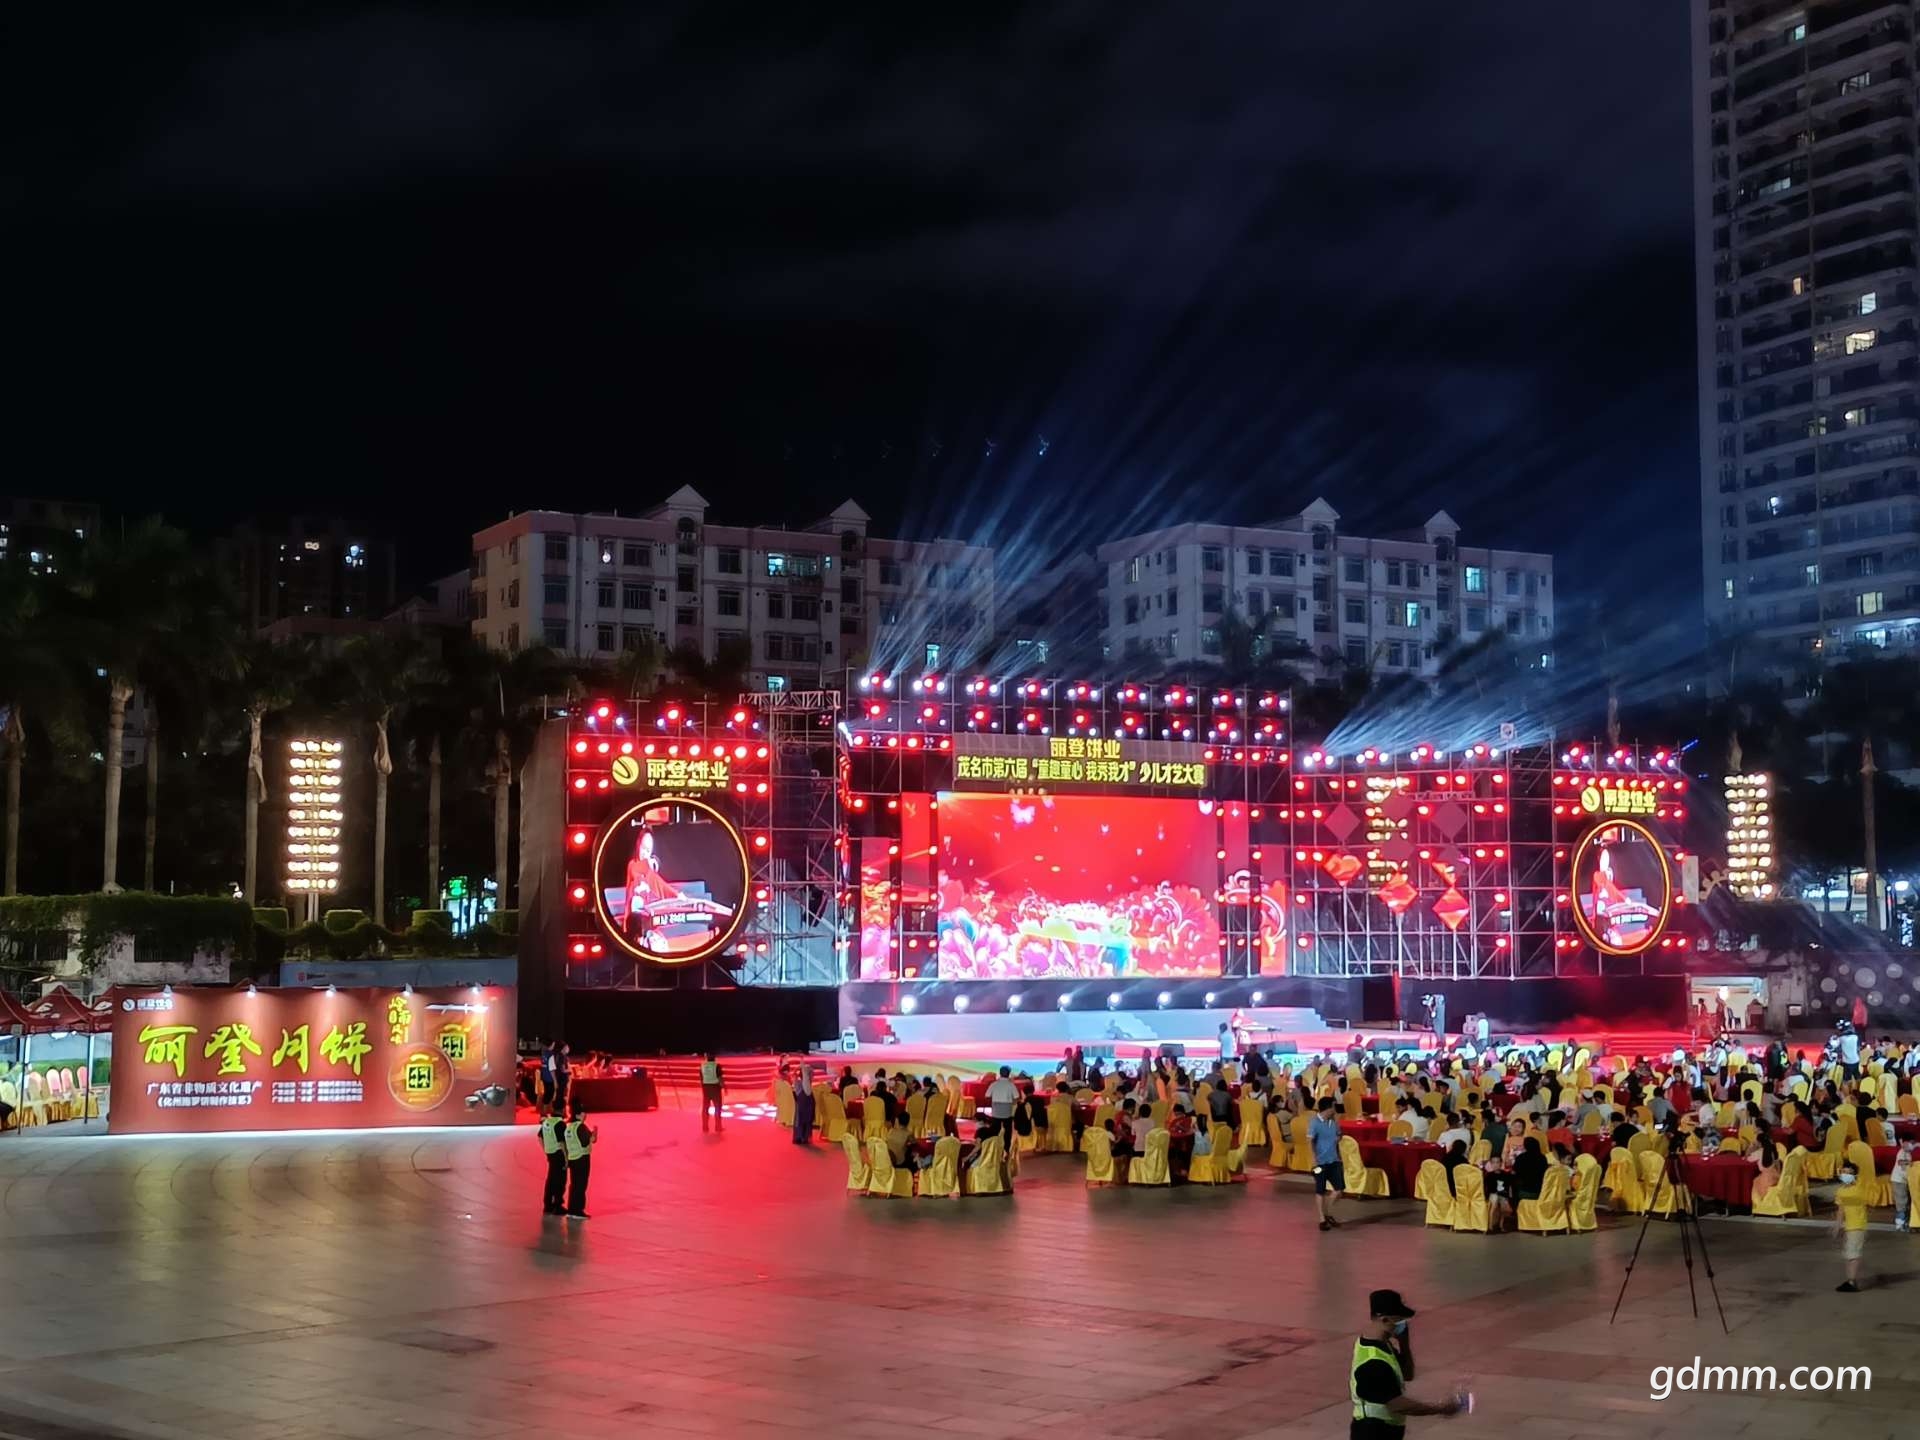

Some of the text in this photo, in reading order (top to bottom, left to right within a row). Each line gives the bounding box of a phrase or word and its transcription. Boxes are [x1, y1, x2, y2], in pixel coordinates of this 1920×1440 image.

[1049, 737, 1121, 759] 丽登饼业
[646, 759, 729, 780] 丽登饼业
[957, 757, 1028, 779] 茂名市第六届
[1139, 763, 1205, 785] 少儿才艺大赛
[139, 1023, 372, 1076] 丽登月饼
